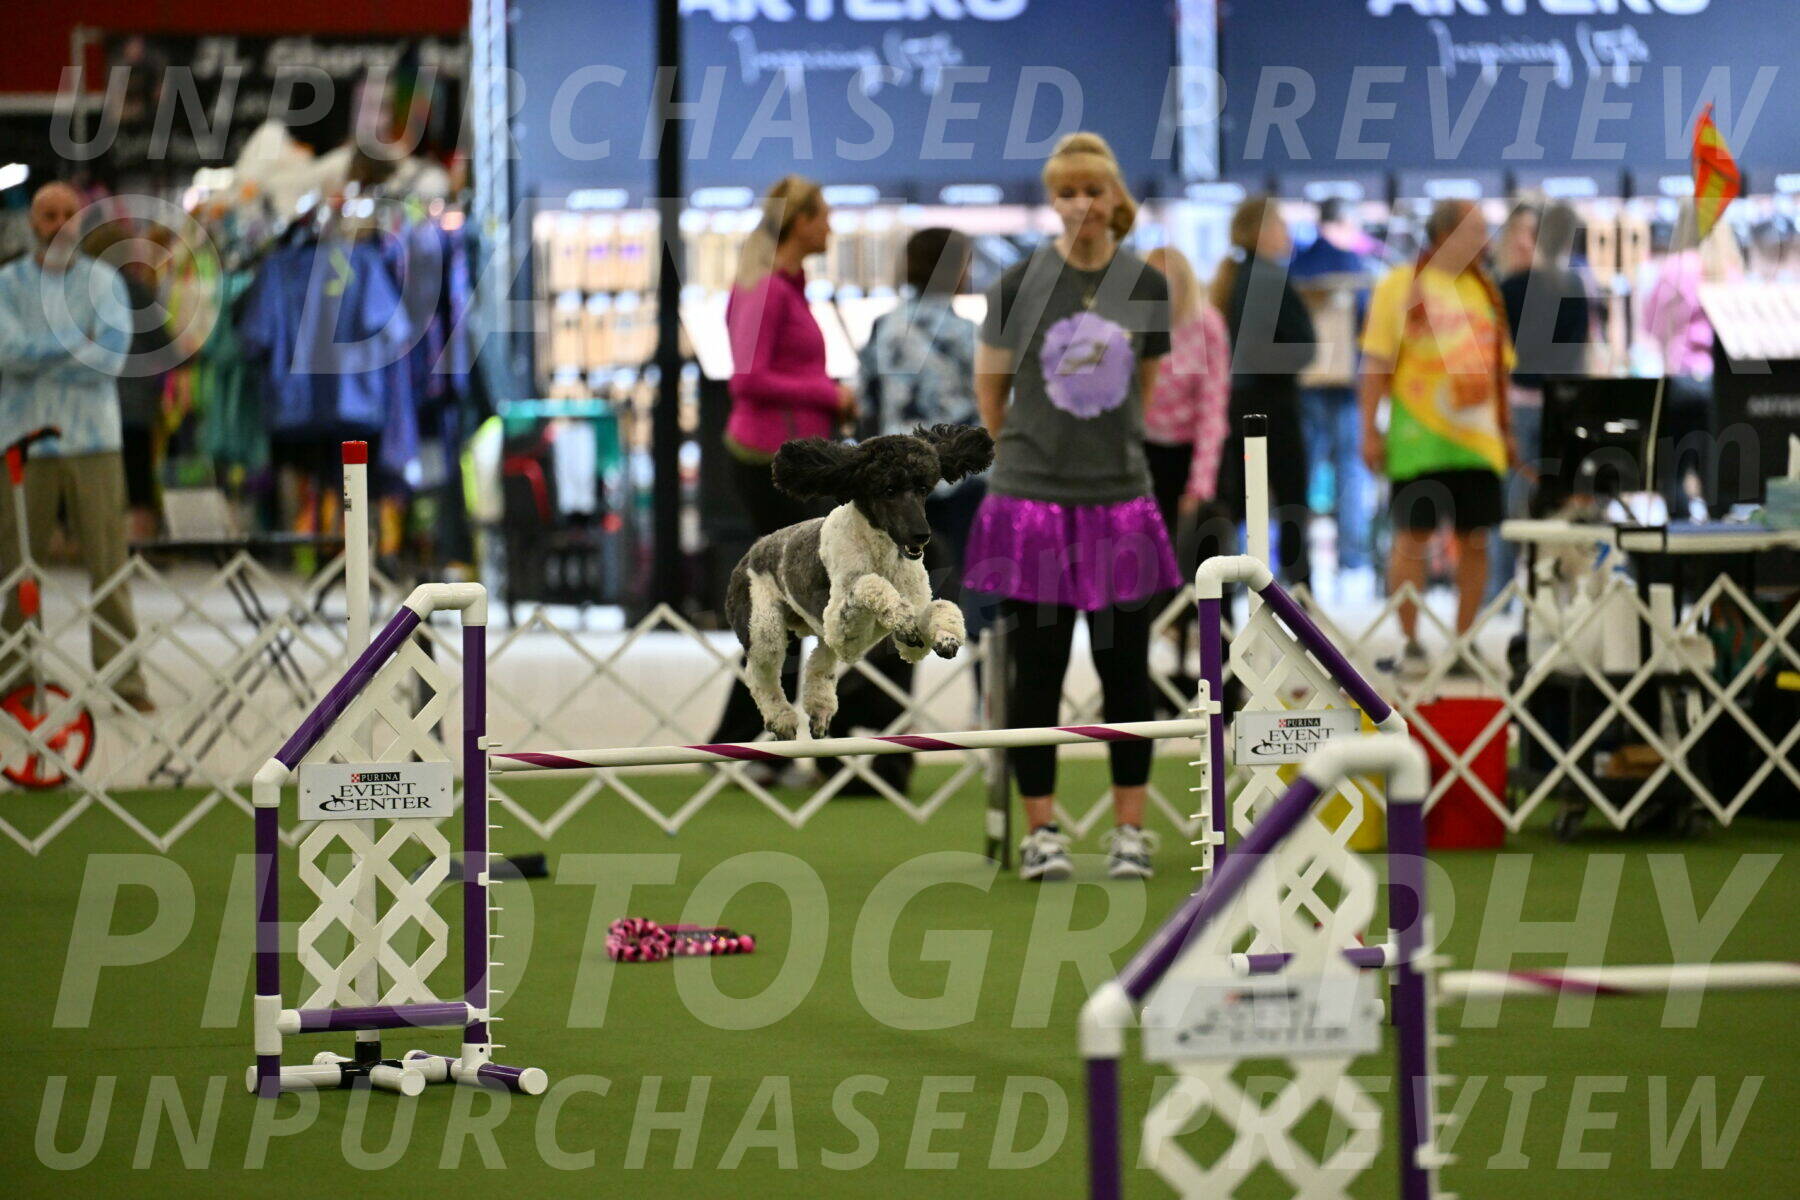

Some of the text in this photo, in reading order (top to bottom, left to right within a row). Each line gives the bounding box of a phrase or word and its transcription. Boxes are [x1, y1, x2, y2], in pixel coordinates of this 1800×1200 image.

[1269, 728, 1334, 741] EVENT
[1251, 741, 1326, 755] CENT
[361, 774, 398, 782] PURINA
[339, 783, 416, 798] EVENT
[319, 797, 432, 811] CENTER
